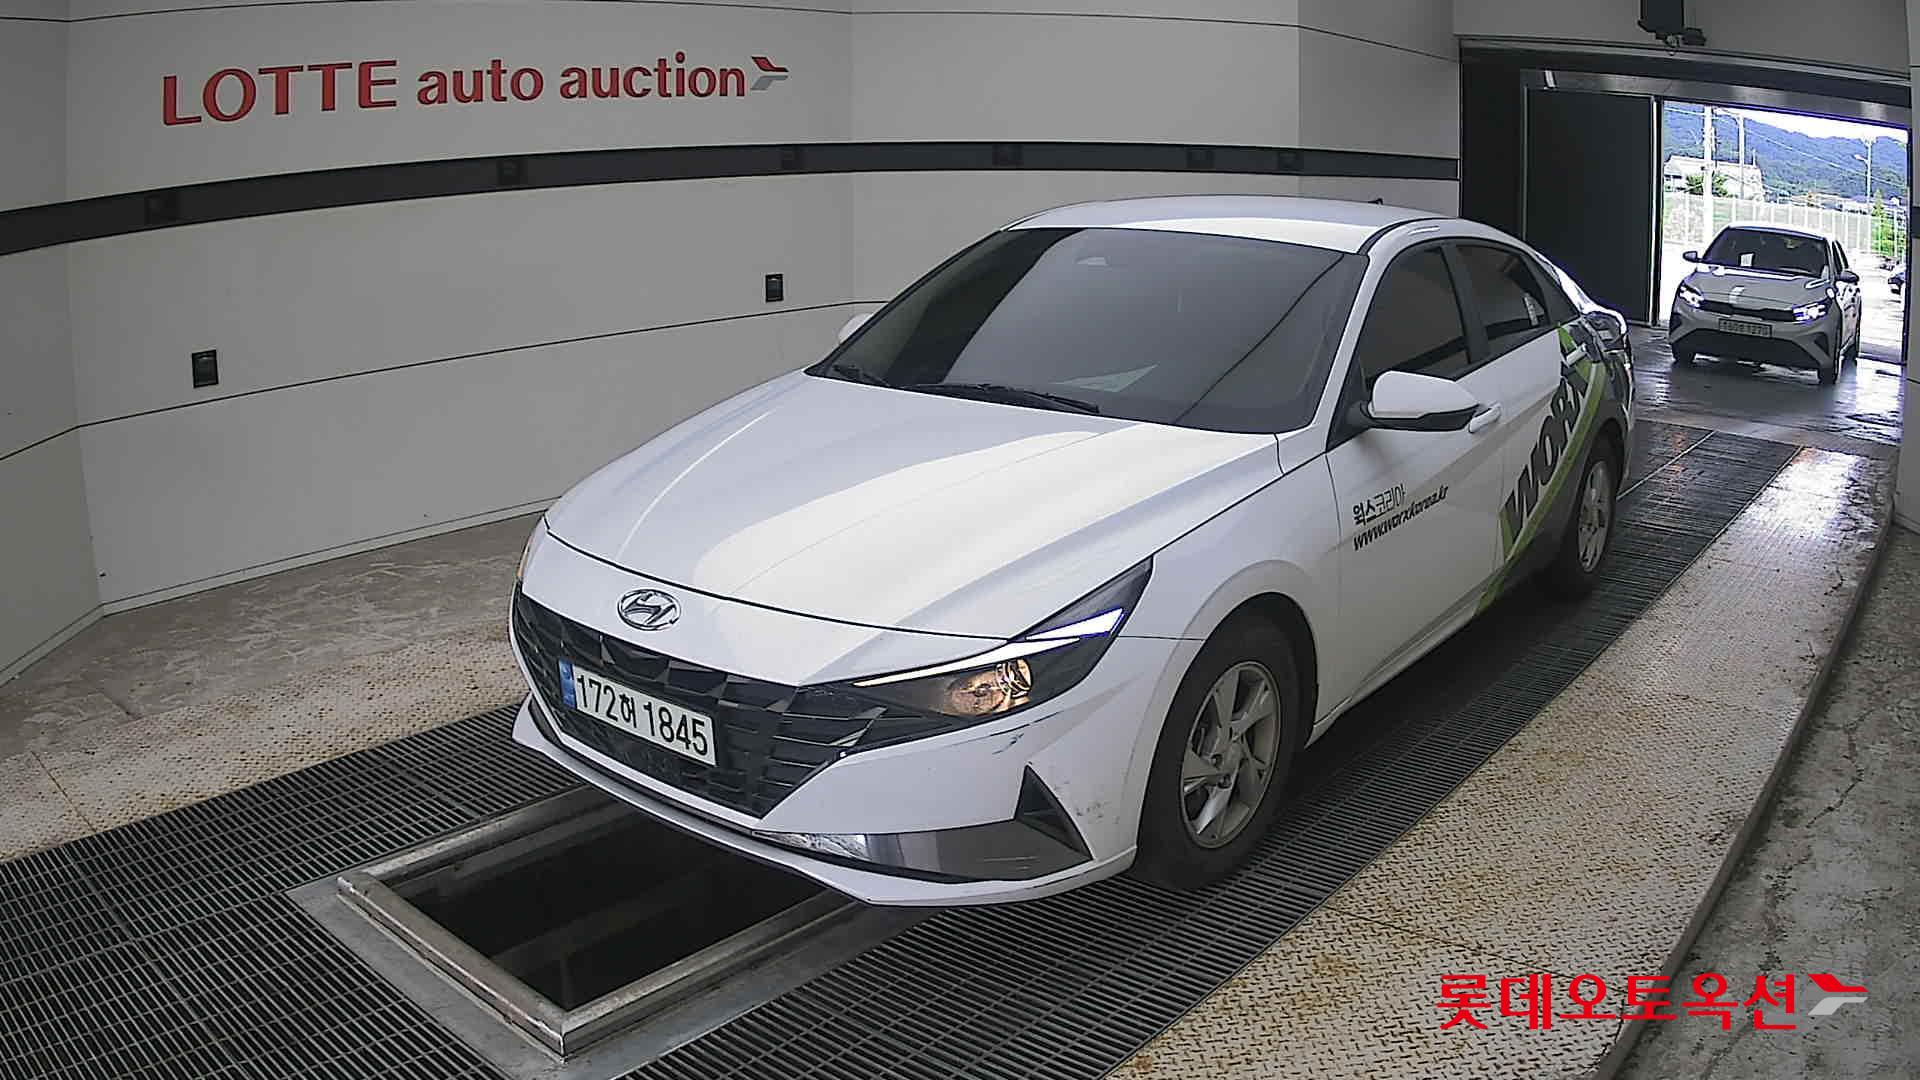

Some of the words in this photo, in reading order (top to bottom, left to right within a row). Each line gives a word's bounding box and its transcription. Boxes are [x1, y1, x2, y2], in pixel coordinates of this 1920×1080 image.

[163, 60, 397, 126] LOTTE
[417, 59, 544, 105] auto
[560, 51, 746, 98] auction
[577, 675, 637, 729] 172허
[644, 701, 708, 756] 1845
